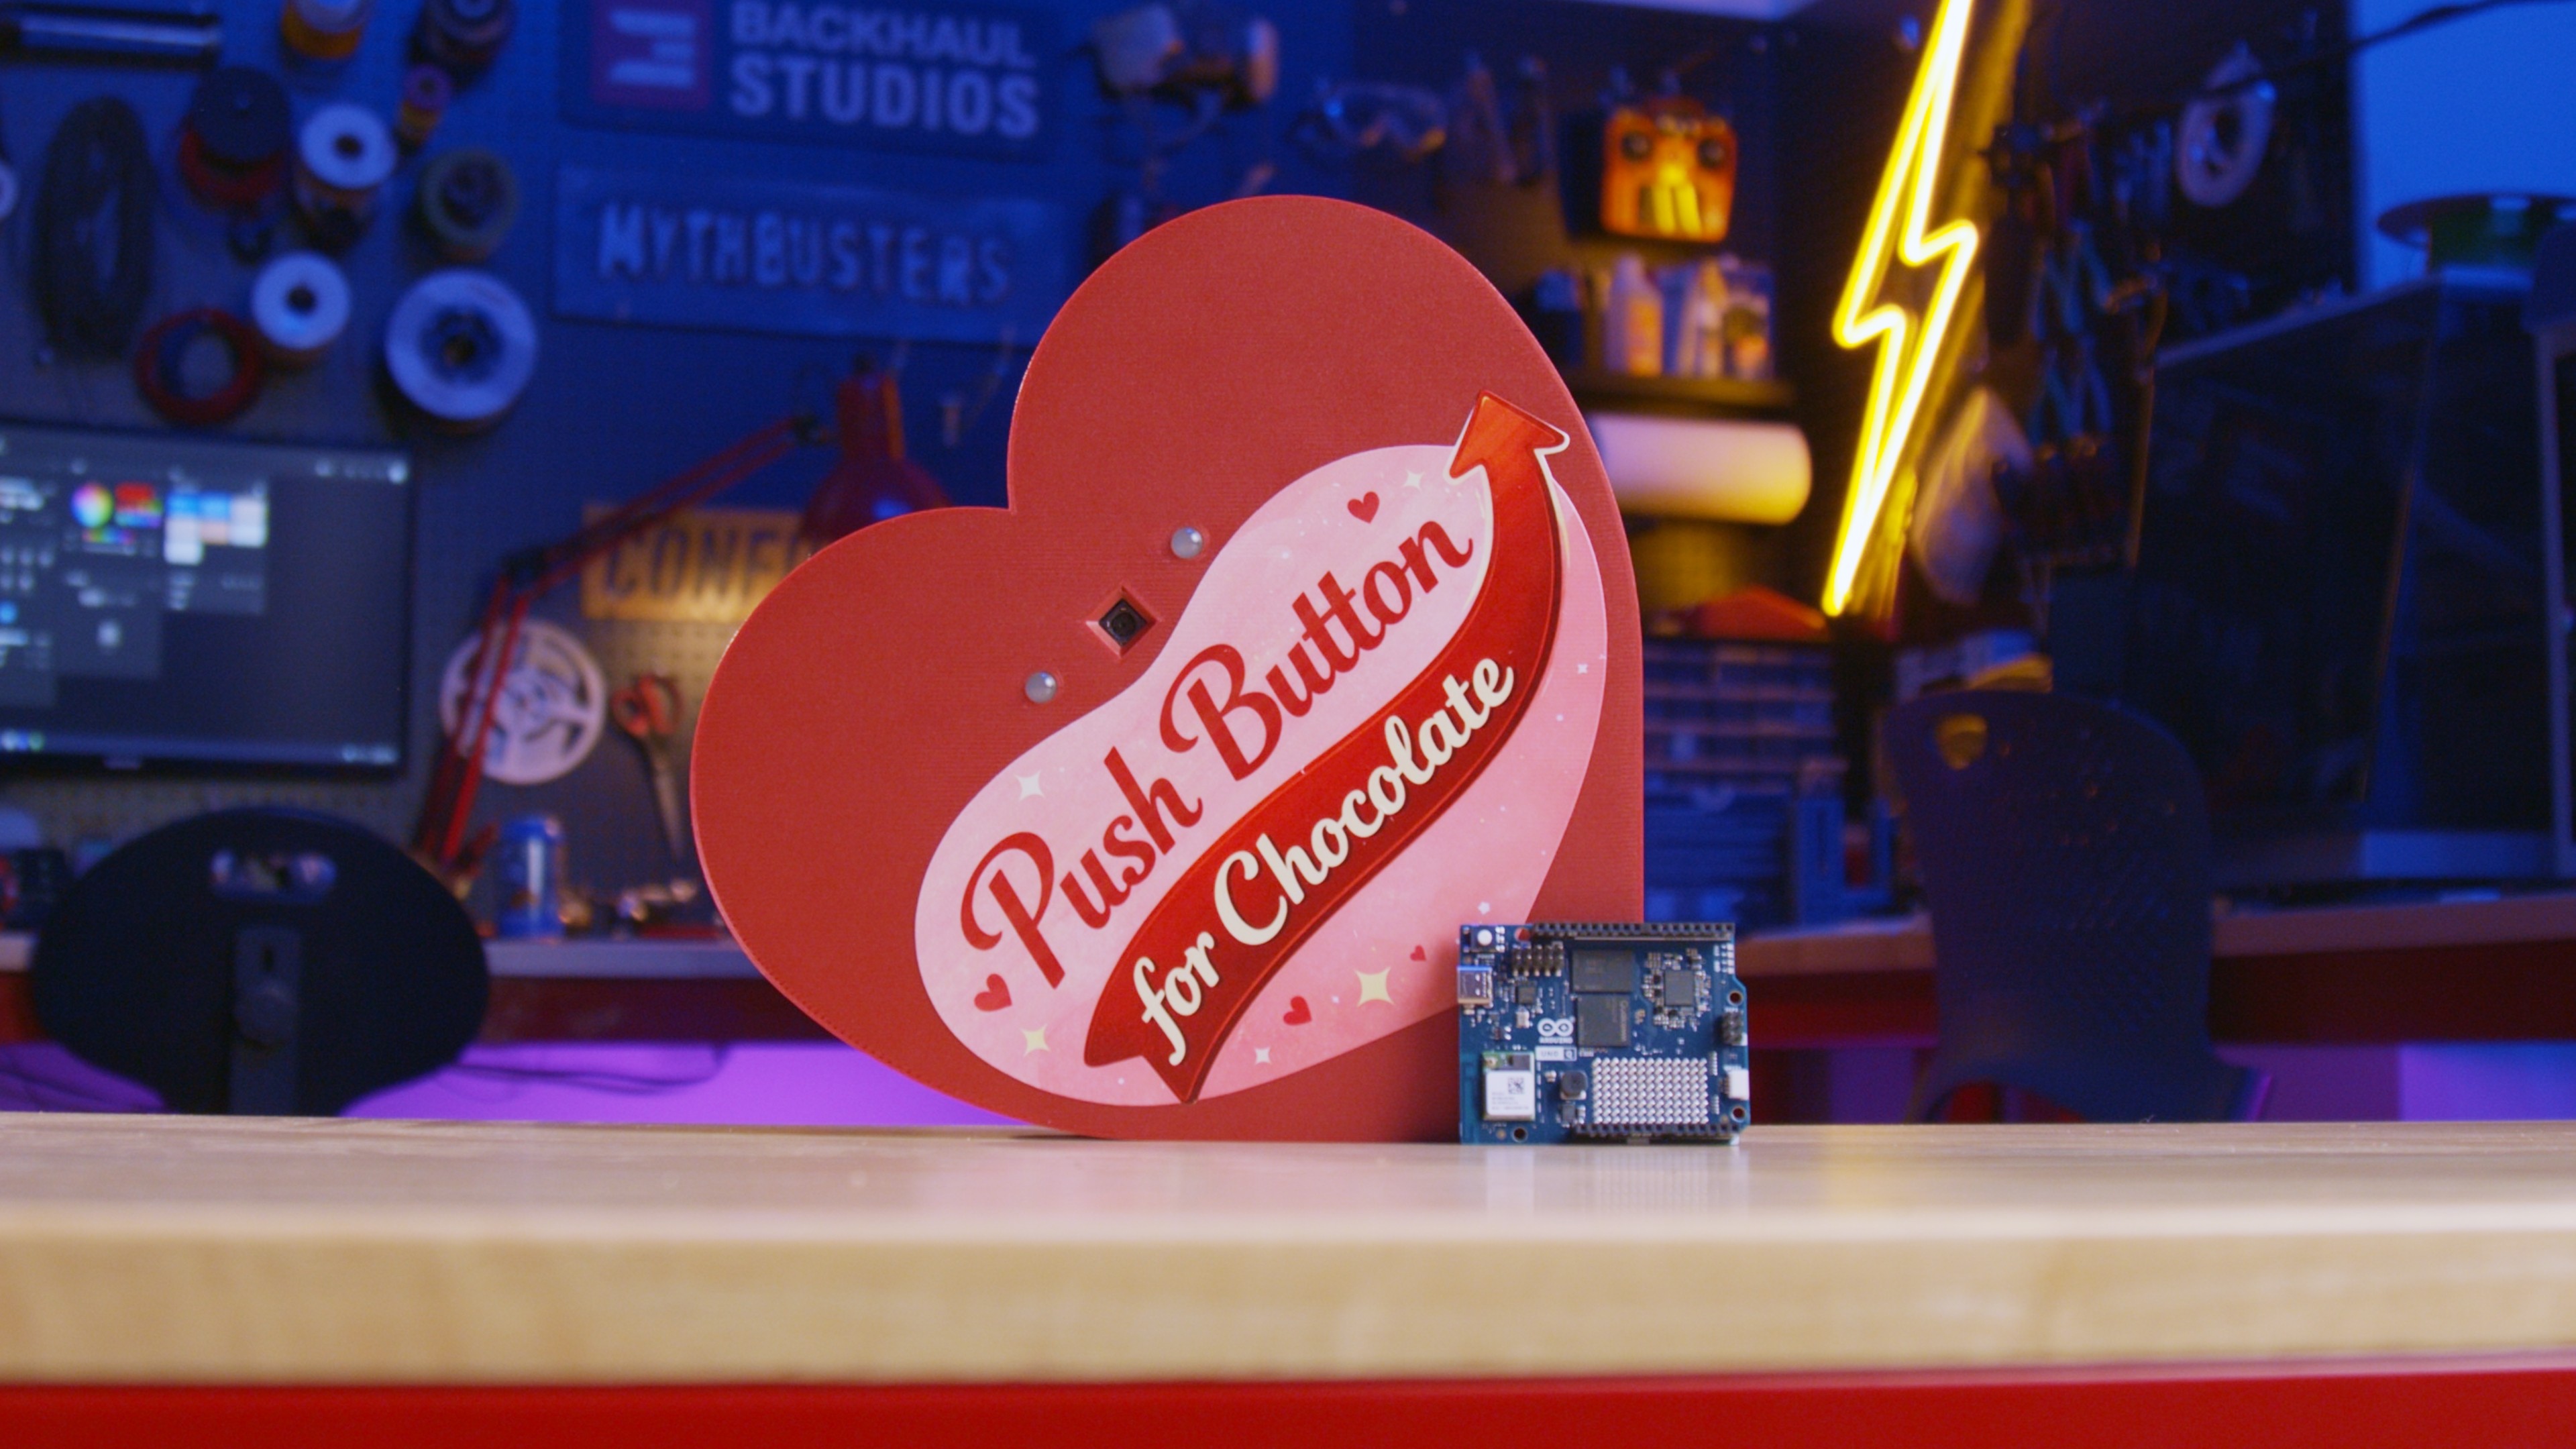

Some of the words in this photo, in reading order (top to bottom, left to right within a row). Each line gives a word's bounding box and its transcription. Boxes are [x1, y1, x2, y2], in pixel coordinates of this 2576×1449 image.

[729, 1, 1036, 68] BACKHAUL
[729, 52, 1038, 138] STUDIOS
[598, 203, 1010, 305] MYTHBUSTERS
[960, 746, 1204, 990] Push
[1159, 521, 1474, 782] Button
[1130, 931, 1224, 1067] for
[1213, 657, 1515, 947] Chocolate
